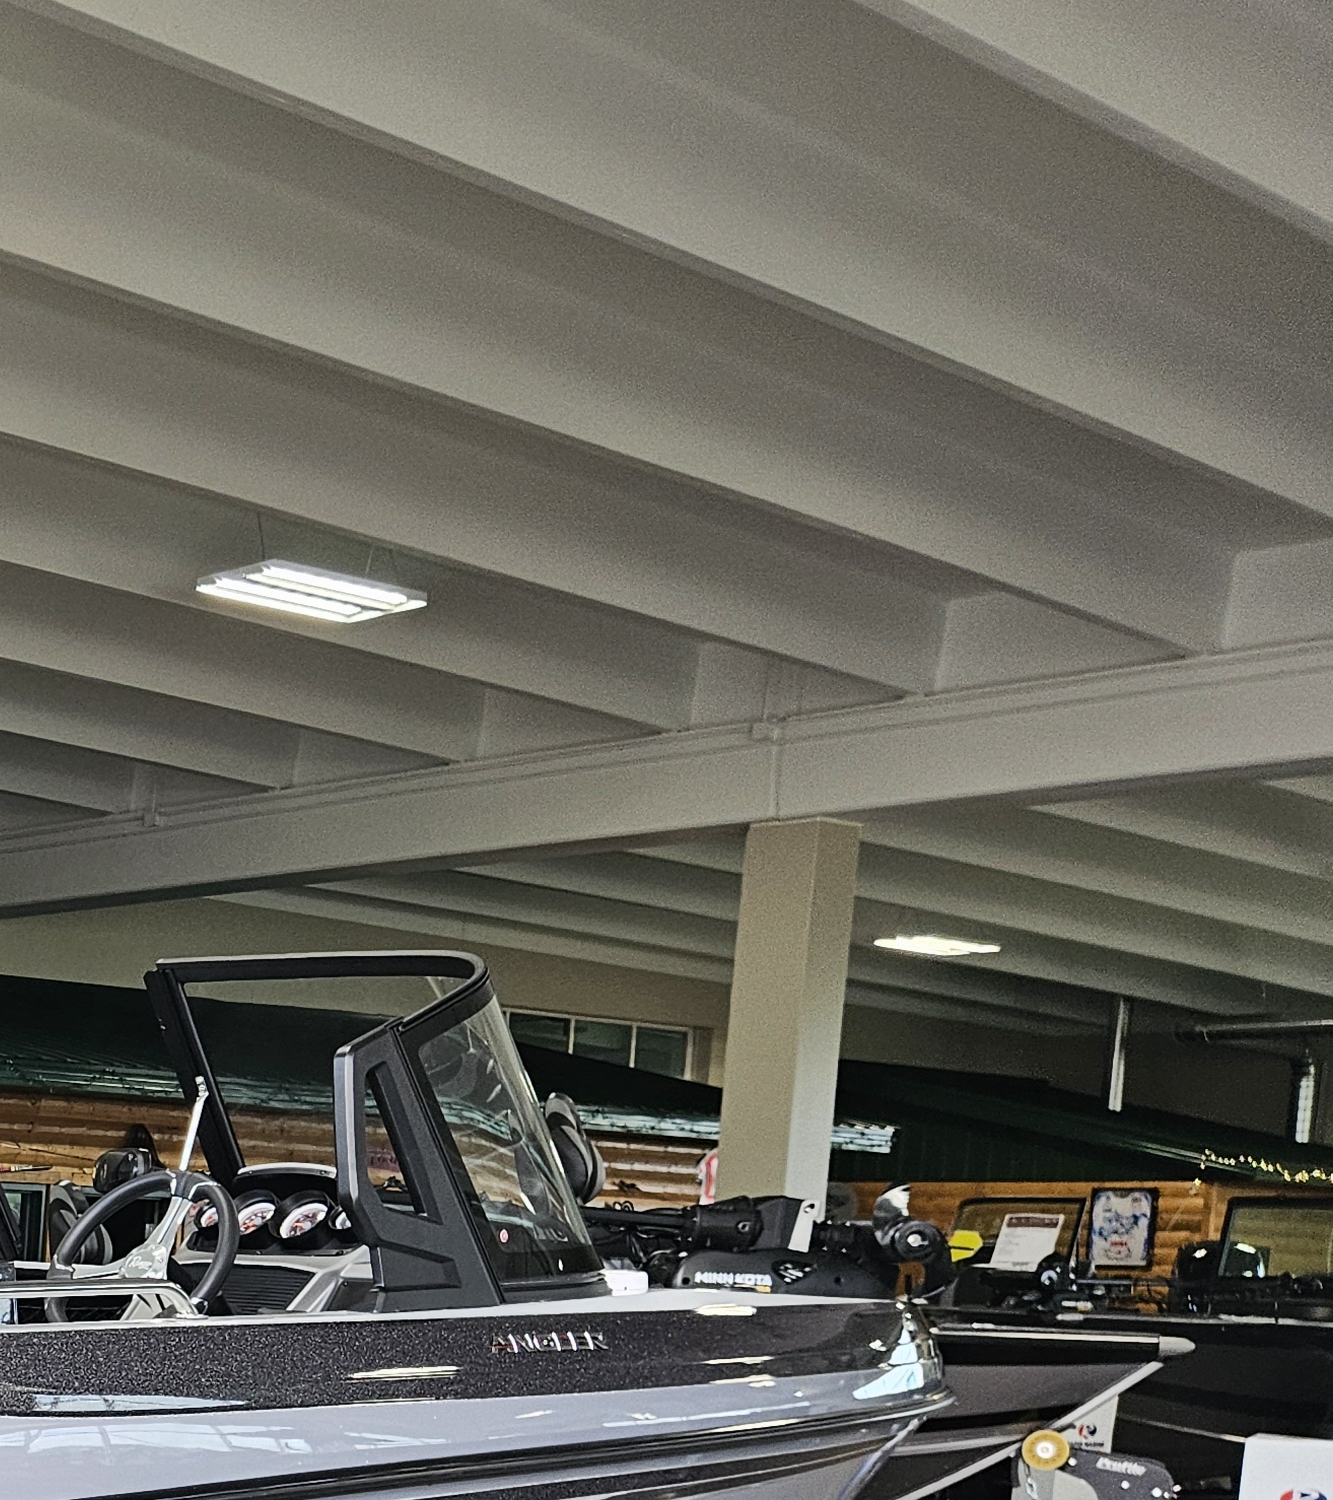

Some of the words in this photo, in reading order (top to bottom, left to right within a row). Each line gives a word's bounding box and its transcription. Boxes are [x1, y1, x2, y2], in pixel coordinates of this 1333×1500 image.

[694, 1271, 734, 1285] MINN
[734, 1273, 773, 1286] KOTA
[490, 1330, 609, 1354] ANGLER
